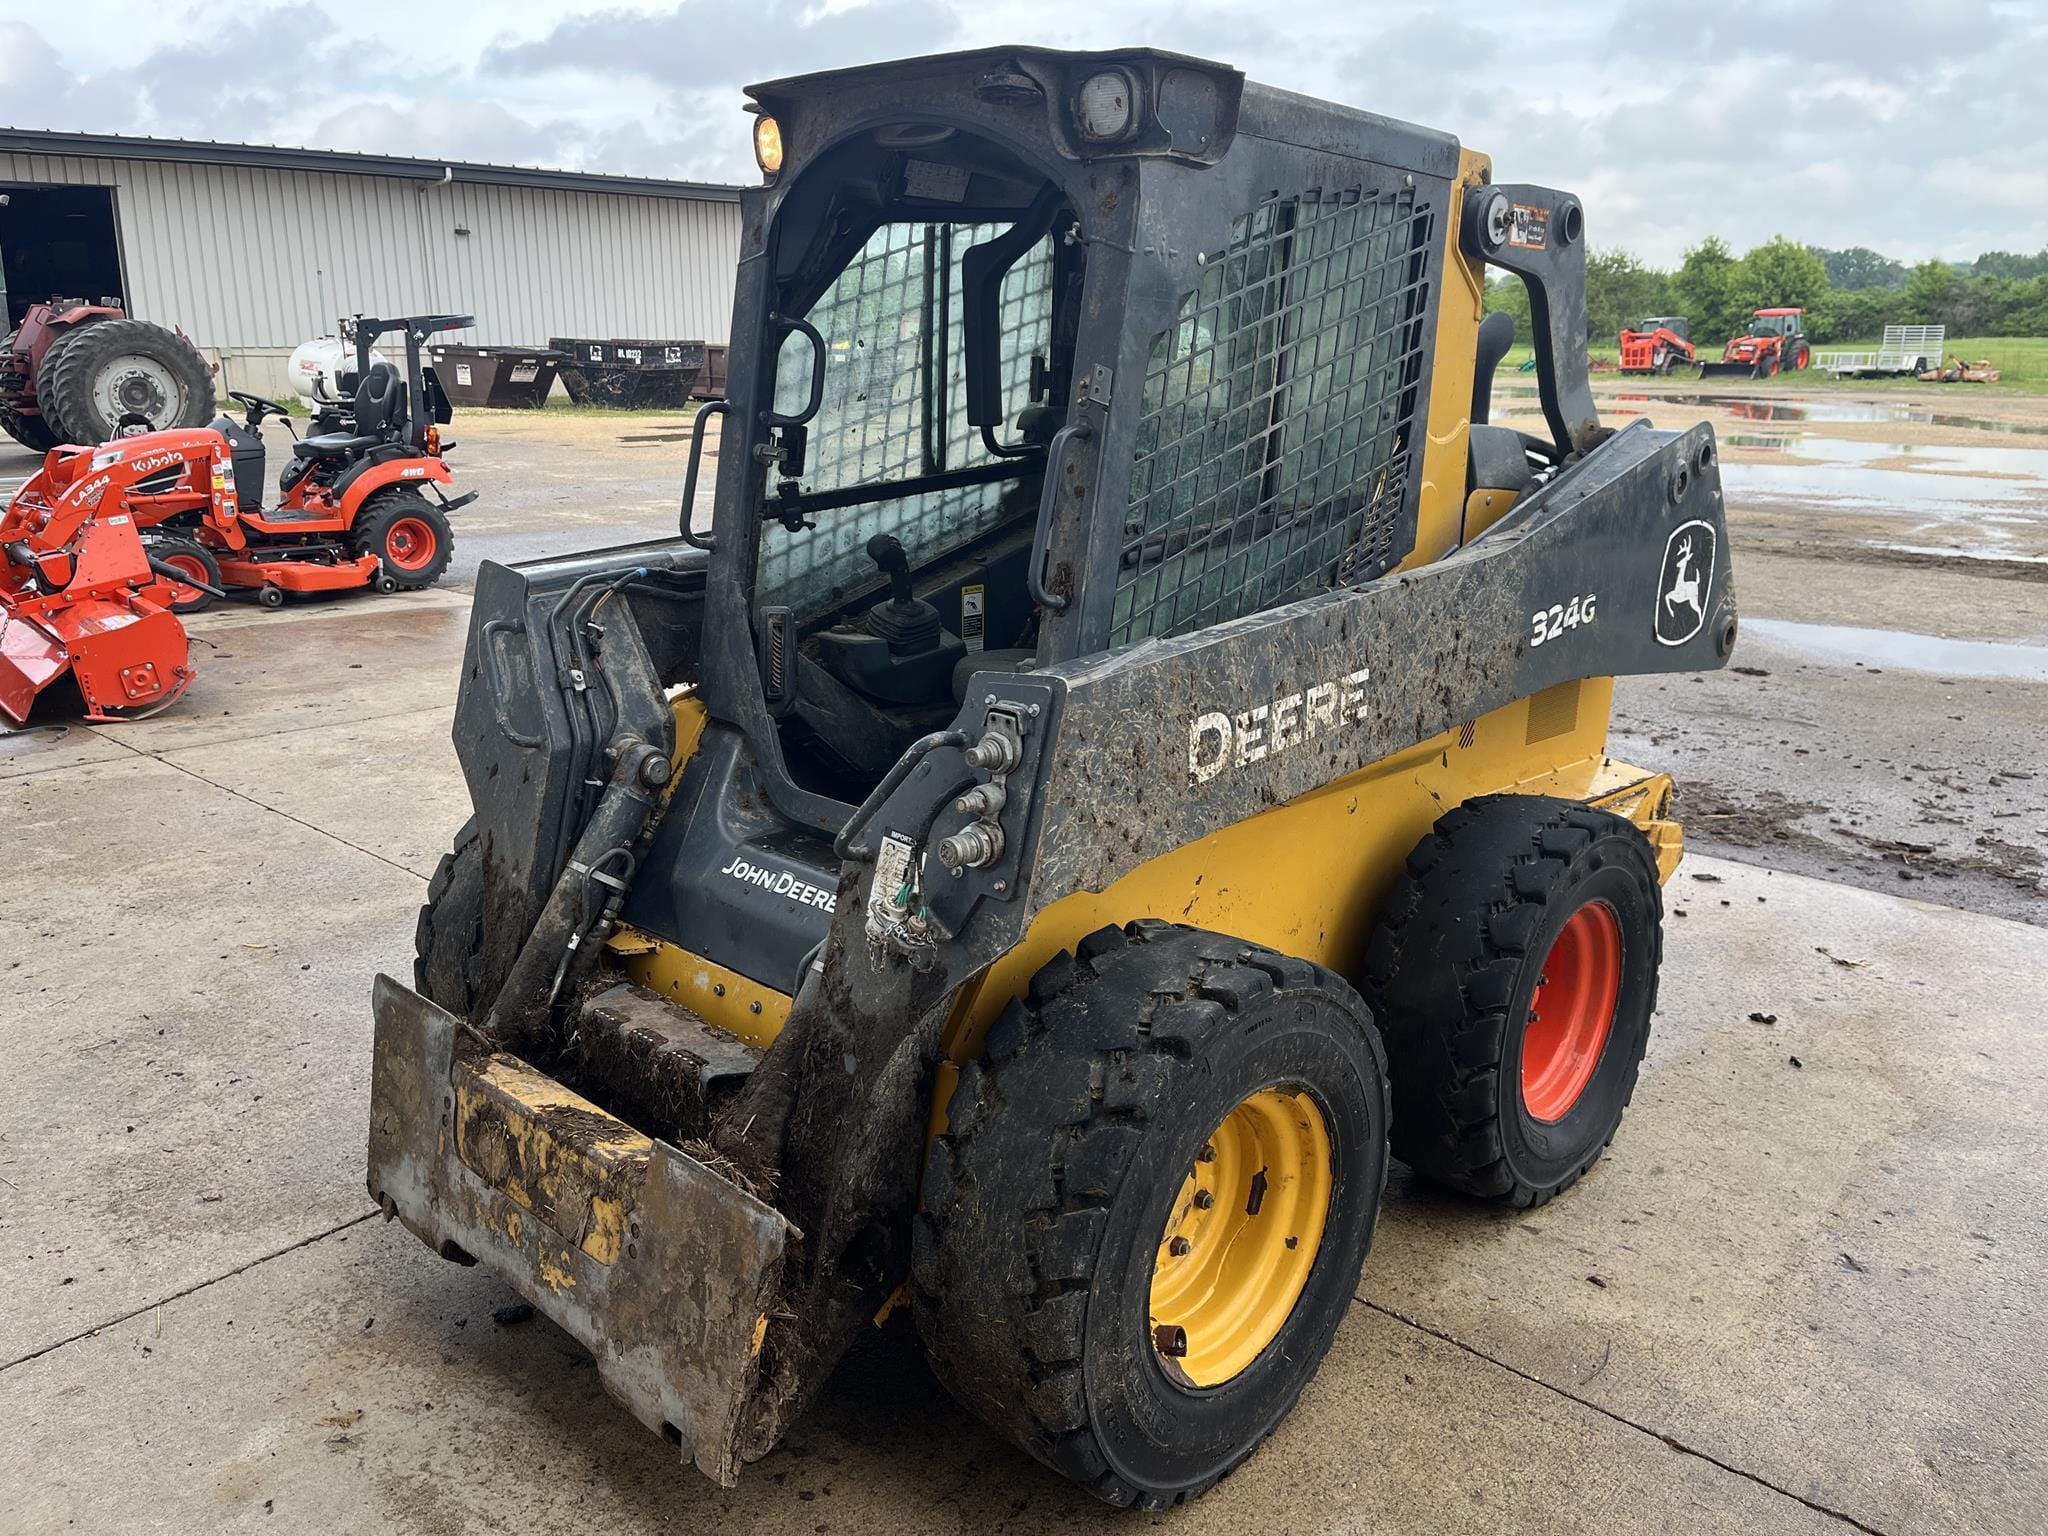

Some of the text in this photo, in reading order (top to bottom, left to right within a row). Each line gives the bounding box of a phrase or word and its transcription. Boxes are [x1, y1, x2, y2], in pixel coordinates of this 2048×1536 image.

[131, 452, 184, 472] Kubota
[400, 467, 424, 477] 4WD
[71, 475, 111, 507] LA344
[1530, 593, 1597, 647] 324G
[1188, 668, 1370, 788] DEERE
[891, 829, 914, 845] IMPORT
[721, 856, 777, 890] JOHN
[772, 872, 838, 914] DEERE
